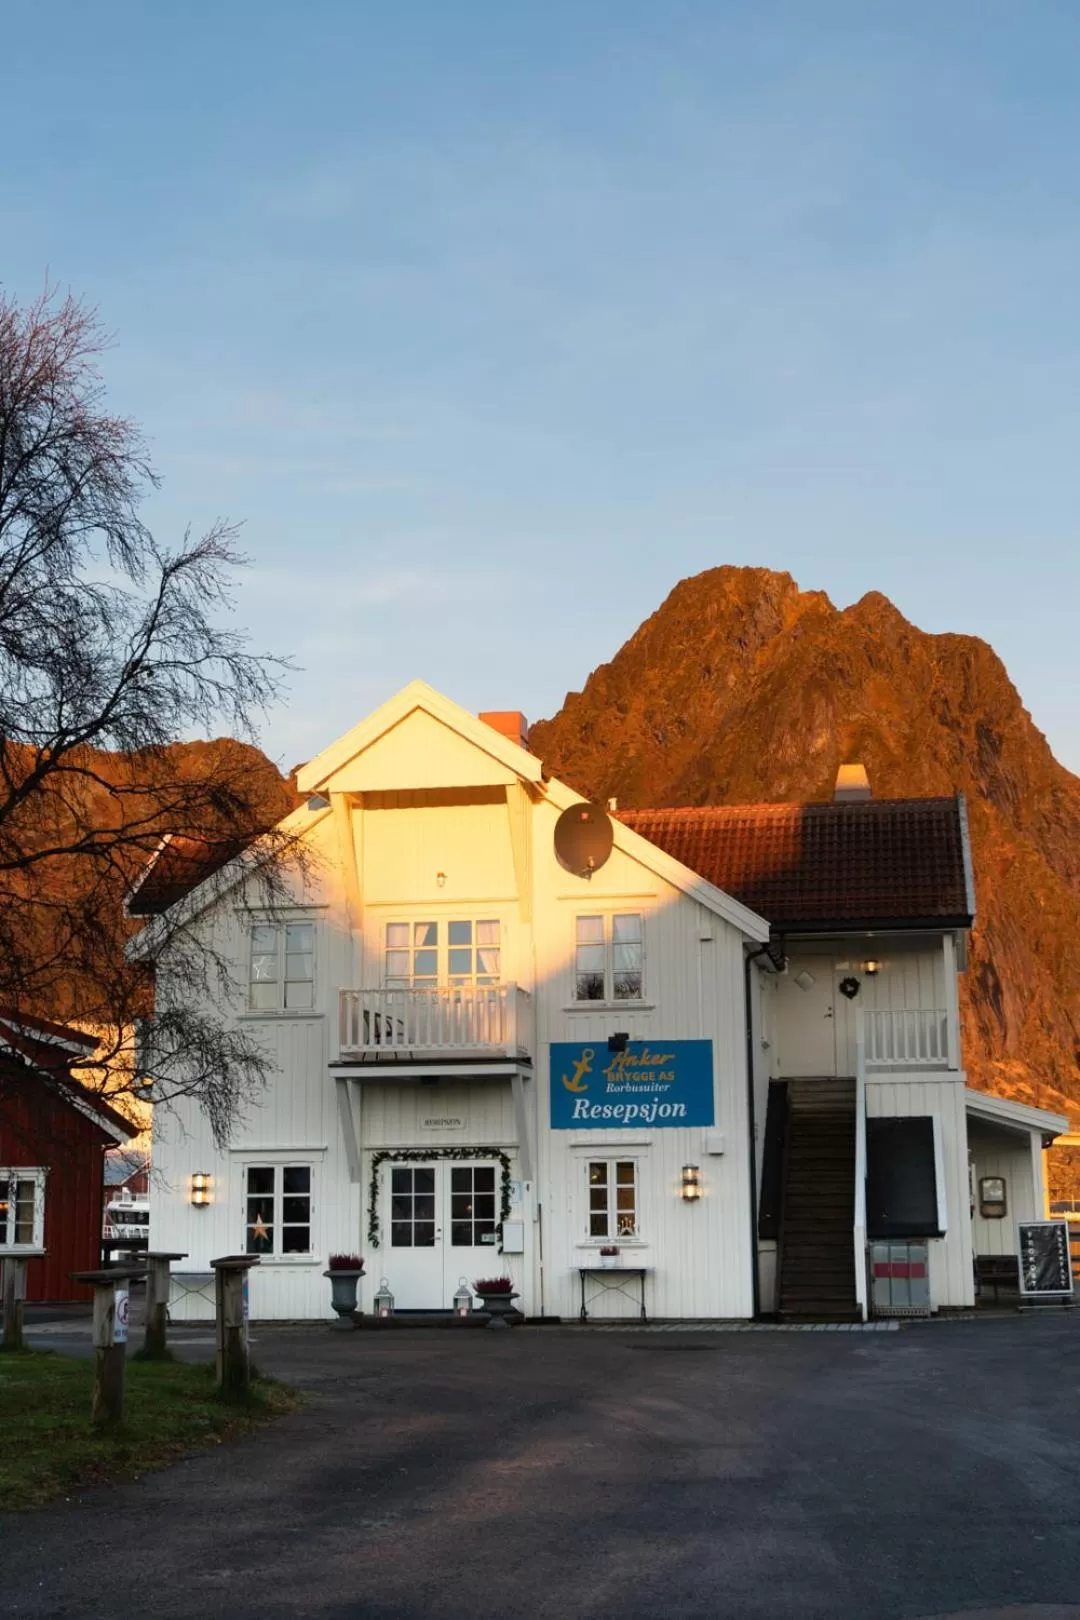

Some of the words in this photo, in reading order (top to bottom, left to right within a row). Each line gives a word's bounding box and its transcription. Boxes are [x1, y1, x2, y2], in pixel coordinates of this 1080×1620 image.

[602, 1047, 675, 1073] Anker
[607, 1071, 656, 1081] BRYGGE
[659, 1071, 675, 1081] AS
[606, 1082, 671, 1094] Rorbusuiter
[571, 1097, 688, 1124] Resepsjon
